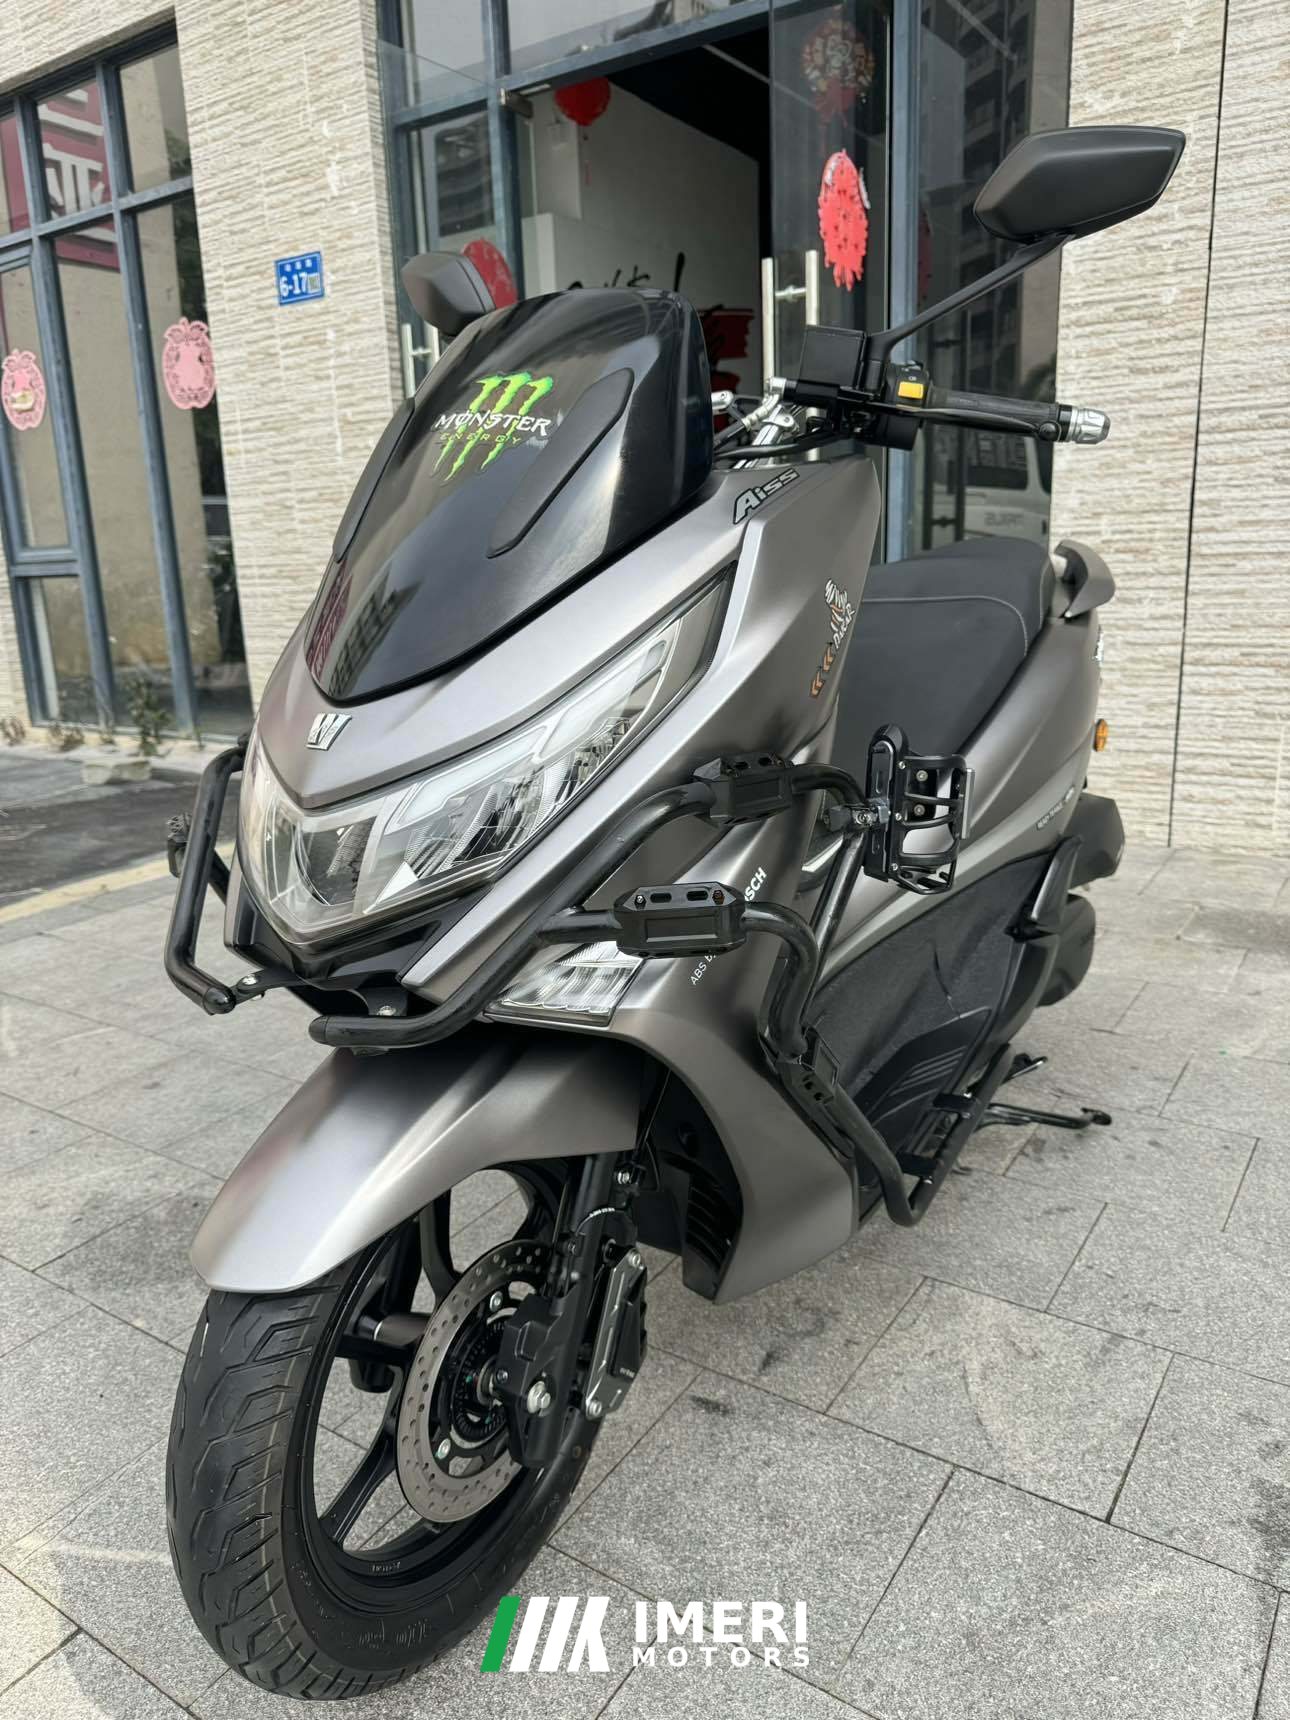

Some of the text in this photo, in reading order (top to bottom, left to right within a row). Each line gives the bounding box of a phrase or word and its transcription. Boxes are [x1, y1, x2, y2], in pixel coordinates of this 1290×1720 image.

[279, 271, 308, 298] 6-17
[434, 409, 552, 437] MONSTER
[439, 432, 522, 445] ENERGY
[690, 961, 708, 986] ABS
[744, 866, 767, 902] SCH
